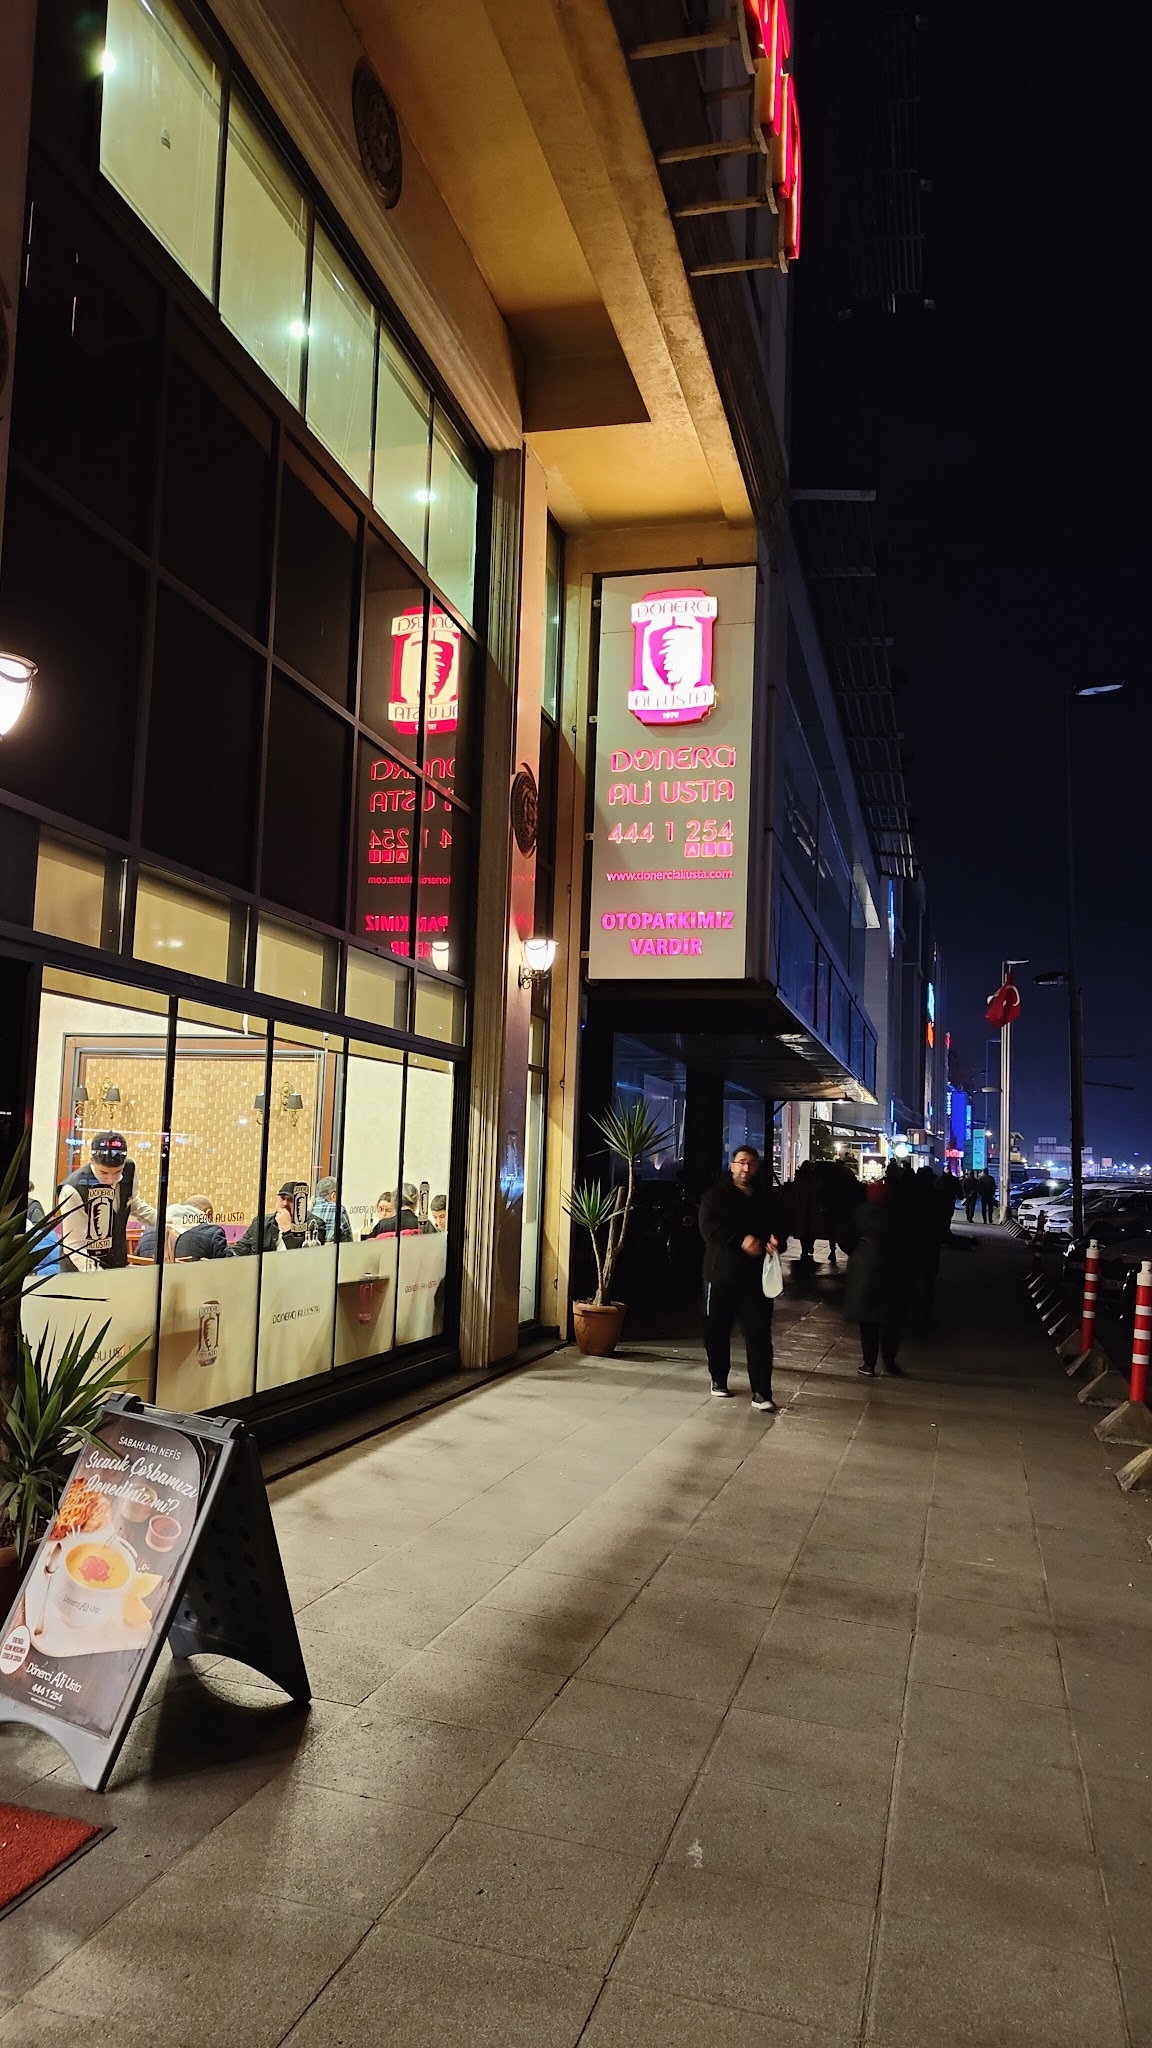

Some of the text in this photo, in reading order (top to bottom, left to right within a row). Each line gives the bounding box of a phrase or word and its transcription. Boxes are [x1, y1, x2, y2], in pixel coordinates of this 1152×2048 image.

[660, 778, 735, 804] USTA
[607, 819, 734, 844] 444 1 254
[629, 938, 703, 956] VARDIR
[118, 1436, 182, 1461] SABAHLARI NEFİS
[84, 1473, 180, 1516] Denediniz mi?
[26, 1662, 55, 1683] Dönerci
[65, 1677, 82, 1694] Usta
[31, 1684, 47, 1696] 444
[49, 1690, 64, 1703] 254
